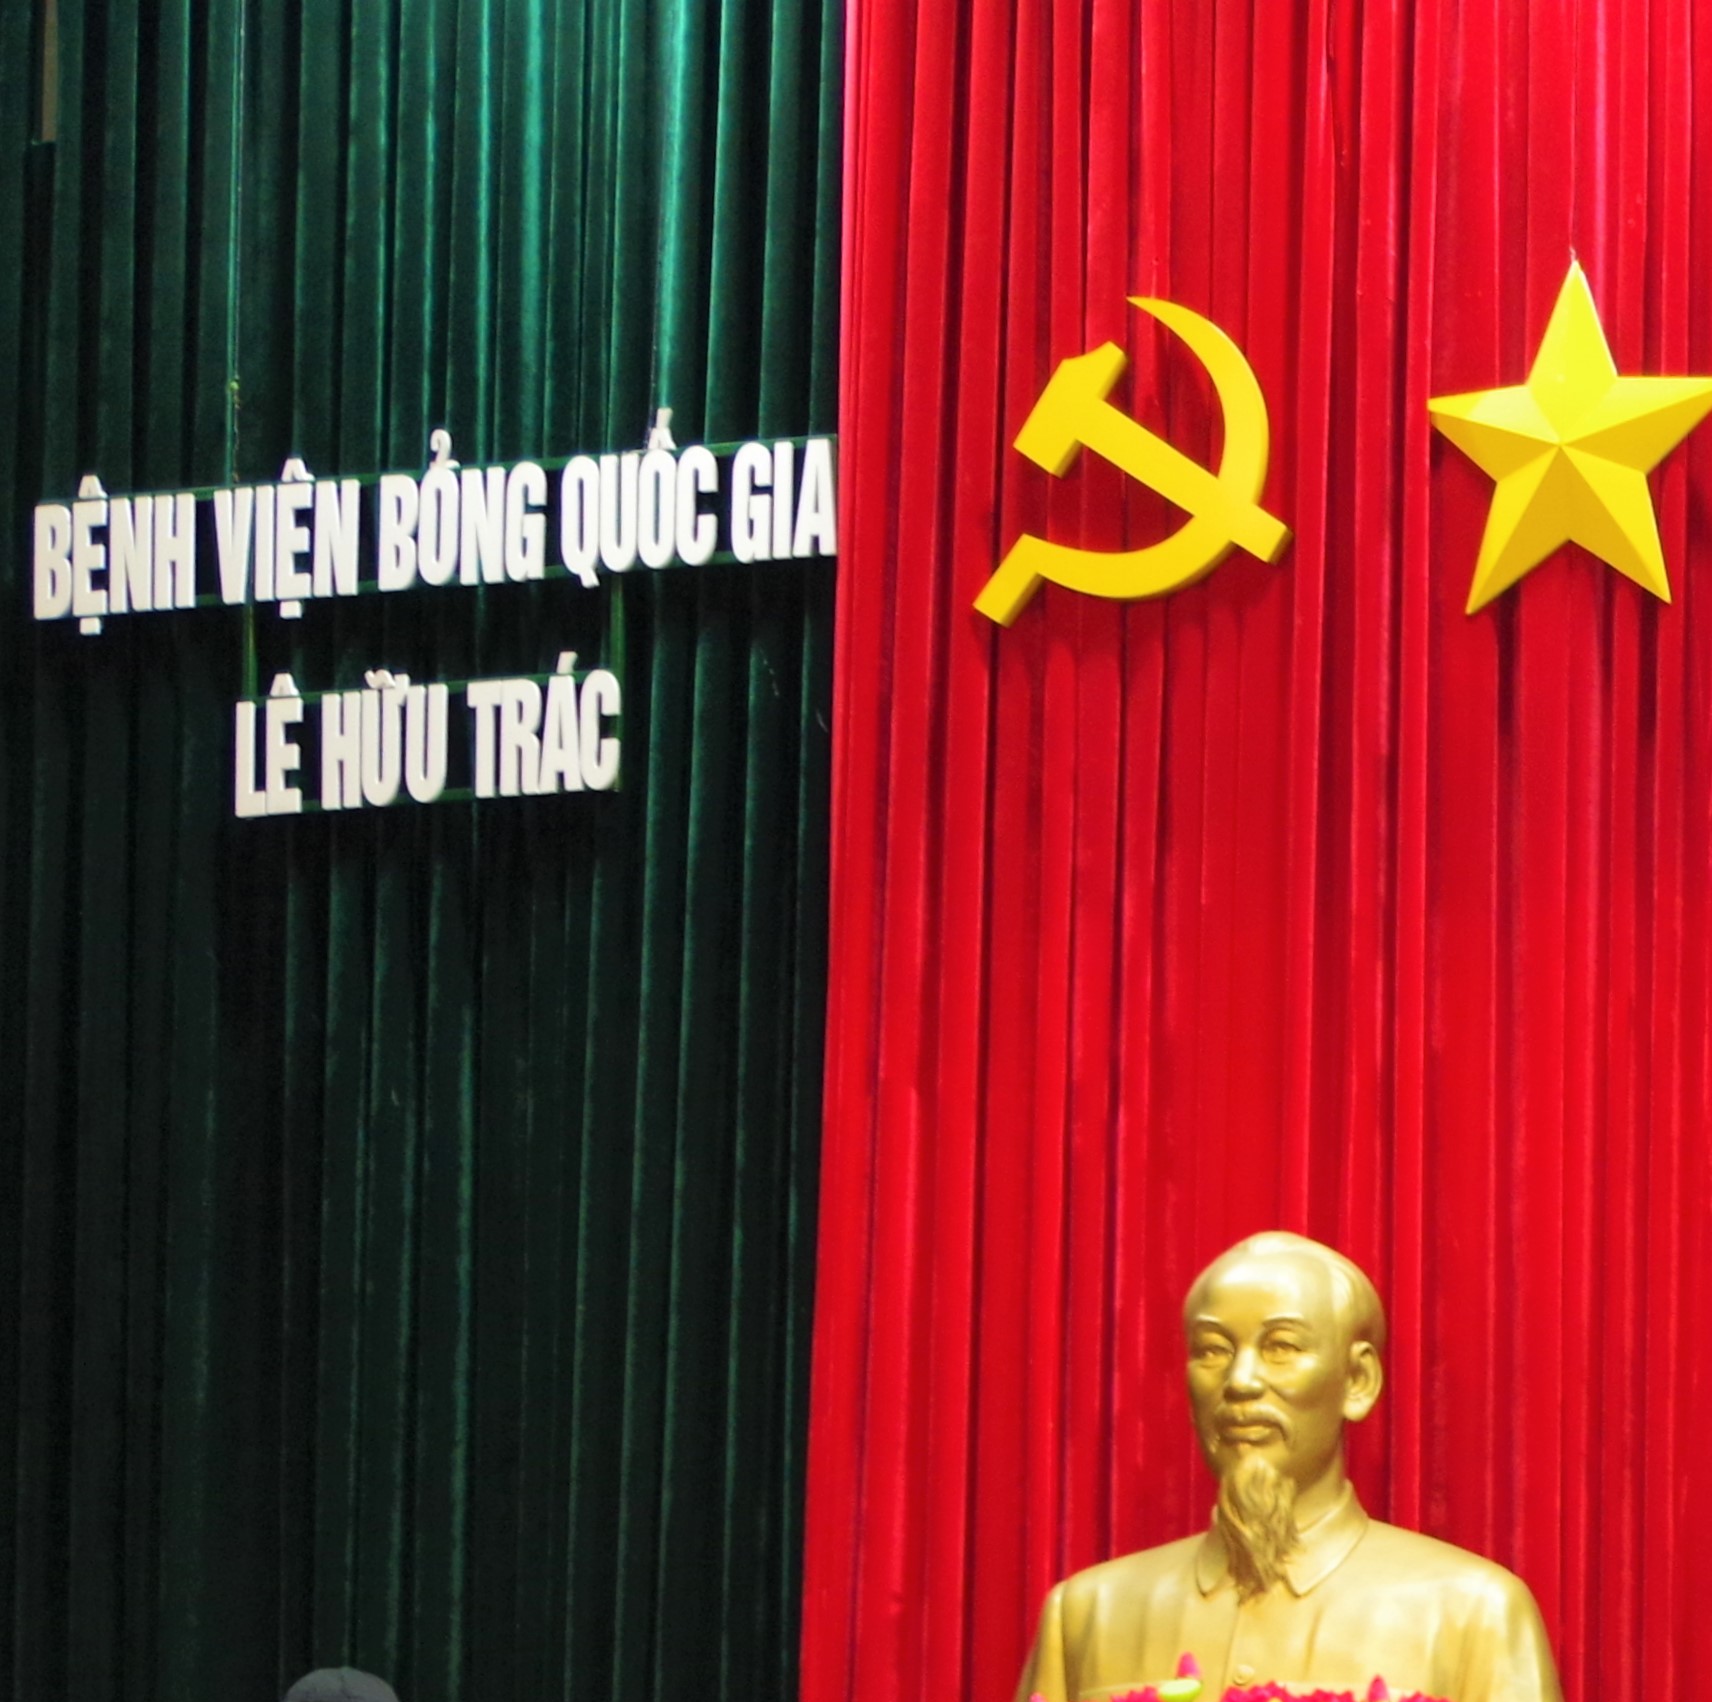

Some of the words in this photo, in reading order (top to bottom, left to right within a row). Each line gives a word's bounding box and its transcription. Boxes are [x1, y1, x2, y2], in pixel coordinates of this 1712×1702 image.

[34, 474, 195, 635] BỆNH
[214, 457, 361, 618] VIỆN
[377, 428, 547, 592] BỎNG
[560, 408, 718, 588] QUỐC
[731, 438, 838, 563] GIA
[235, 672, 304, 818] LÊ
[321, 668, 449, 811] HỮU
[467, 651, 622, 798] TRÁC
